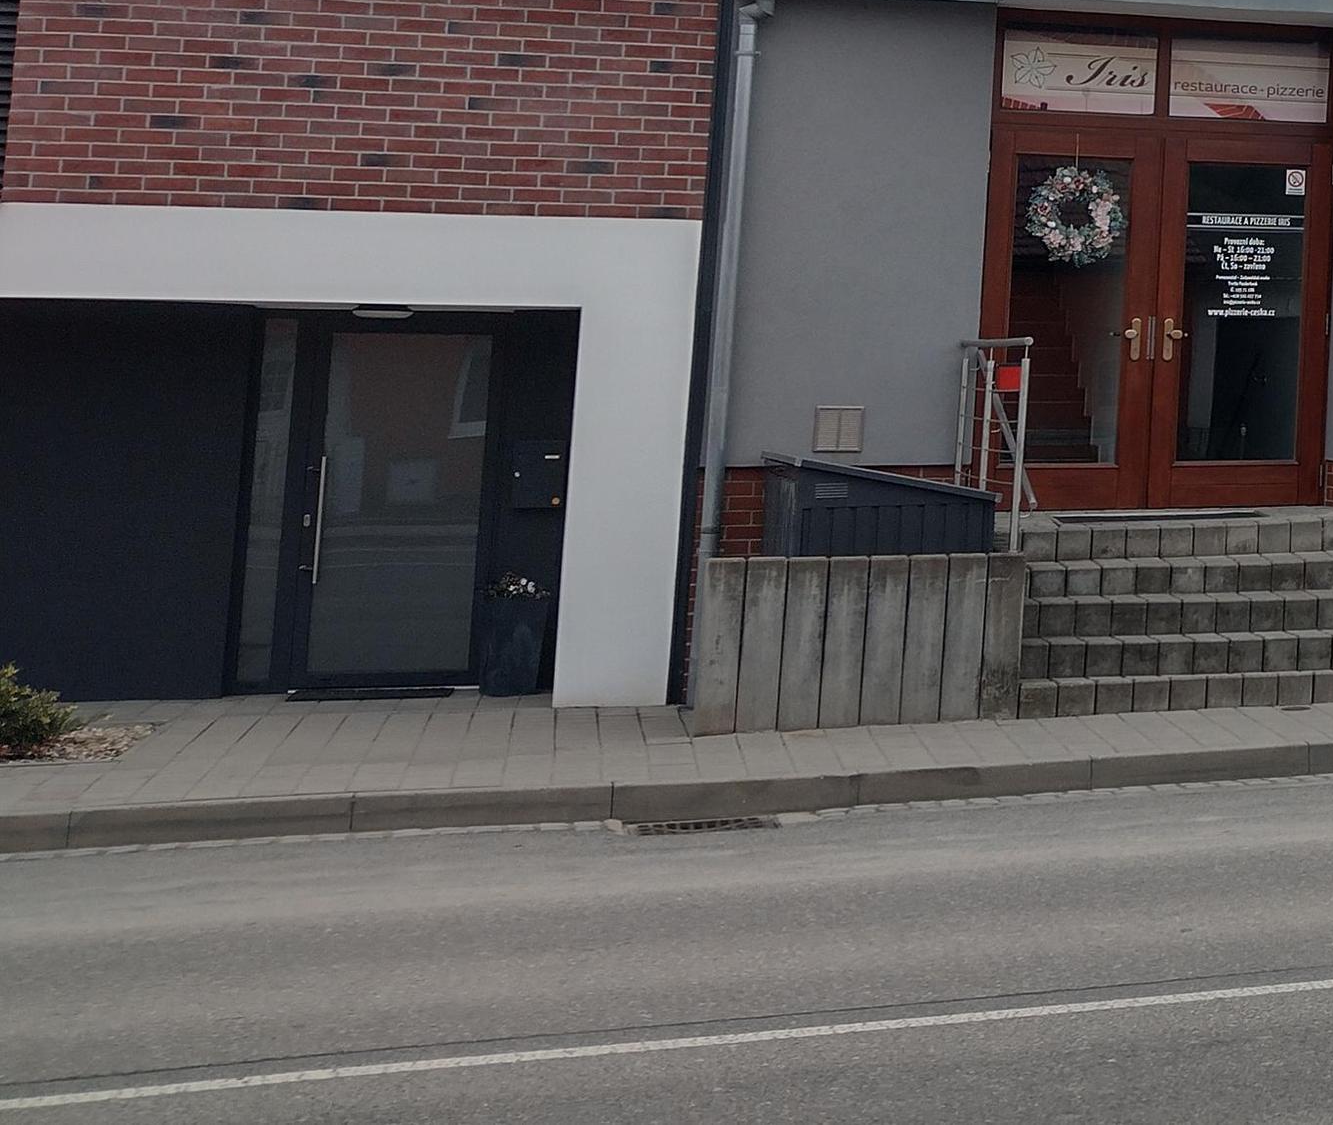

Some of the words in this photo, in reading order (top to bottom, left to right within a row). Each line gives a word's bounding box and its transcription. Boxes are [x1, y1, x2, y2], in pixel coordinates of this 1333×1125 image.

[1066, 55, 1150, 89] Iris
[1173, 80, 1257, 95] restaurace
[1266, 82, 1326, 99] pizzerie
[1202, 215, 1243, 225] RESTAURACE
[1243, 217, 1249, 226] A
[1249, 217, 1278, 226] PIZZERIE
